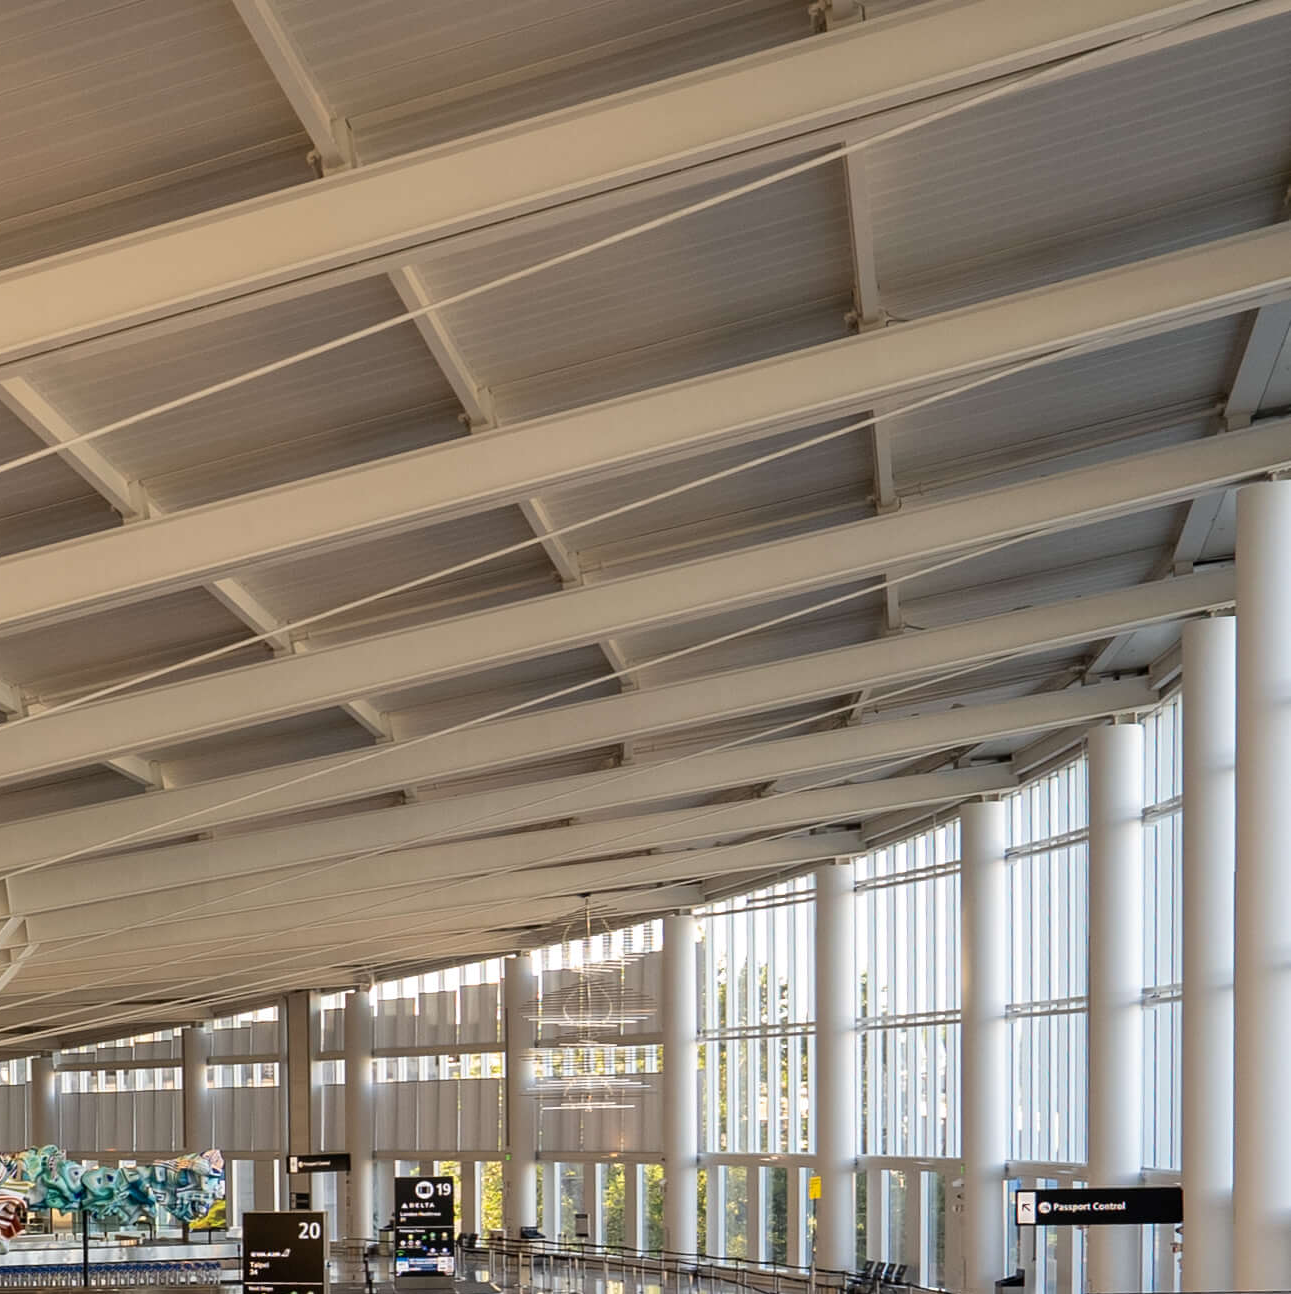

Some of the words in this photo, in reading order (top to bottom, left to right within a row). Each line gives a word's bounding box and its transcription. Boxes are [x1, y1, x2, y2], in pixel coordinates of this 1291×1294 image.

[436, 1182, 451, 1196] 19
[1053, 1202, 1091, 1212] Passport
[1092, 1201, 1126, 1211] Control
[298, 1222, 321, 1239] 20
